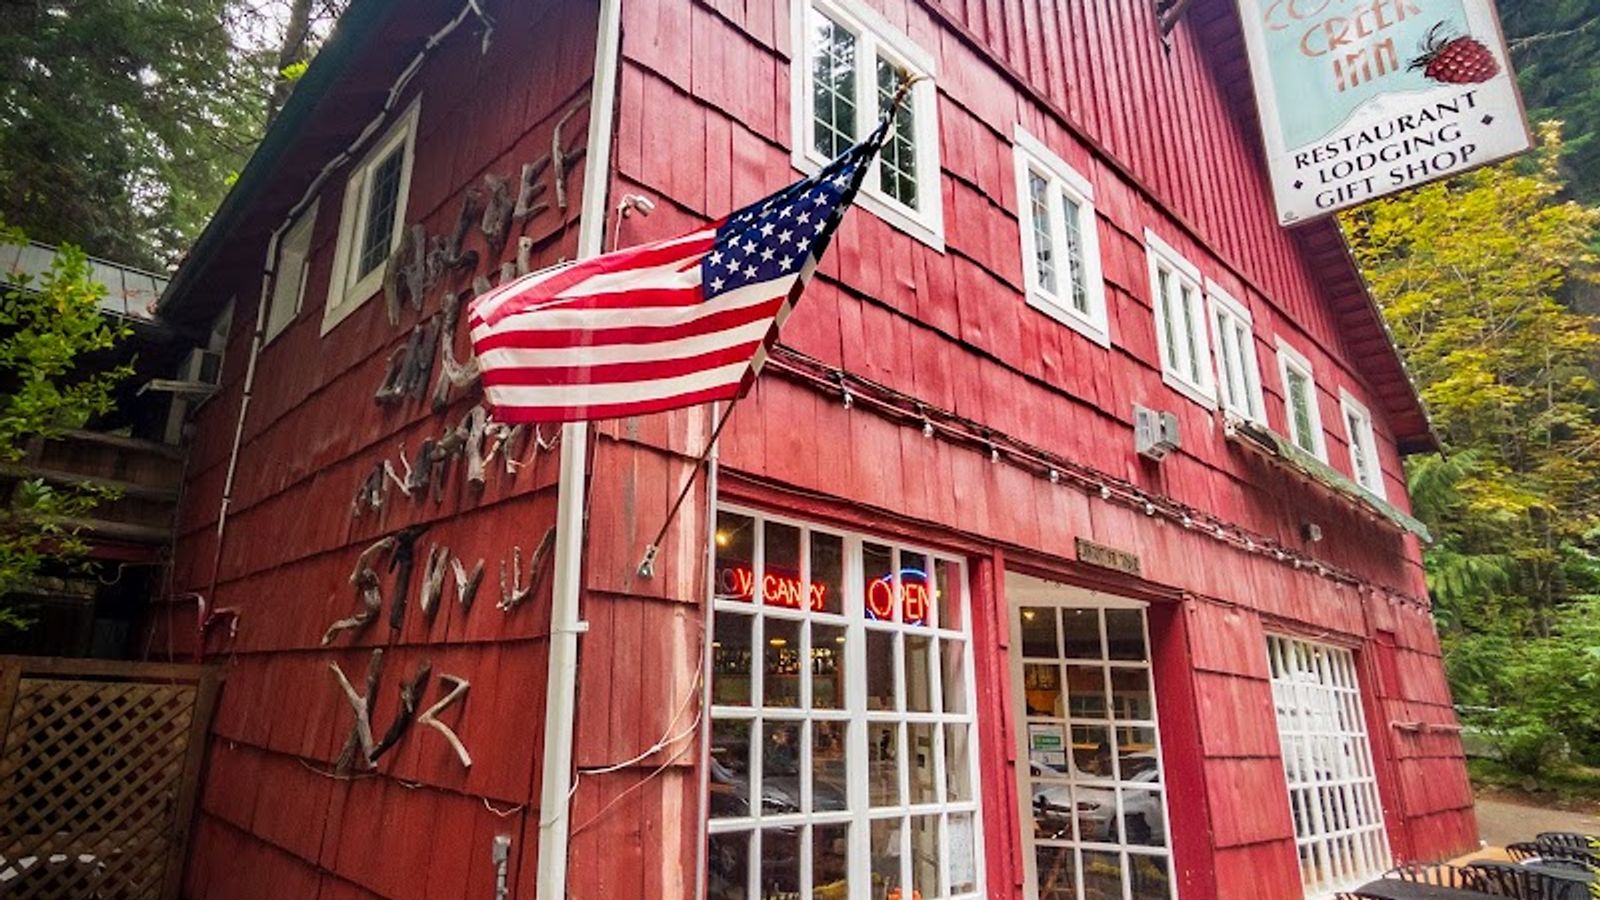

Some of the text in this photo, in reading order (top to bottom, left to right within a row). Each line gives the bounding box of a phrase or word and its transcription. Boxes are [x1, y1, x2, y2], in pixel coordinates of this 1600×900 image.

[1300, 0, 1422, 57] CREEK
[1333, 37, 1399, 92] INN
[1295, 90, 1478, 170] RESTAURANT
[1319, 123, 1462, 184] LODGING
[1315, 143, 1477, 210] GIFT SHOP
[735, 568, 826, 609] VCANY
